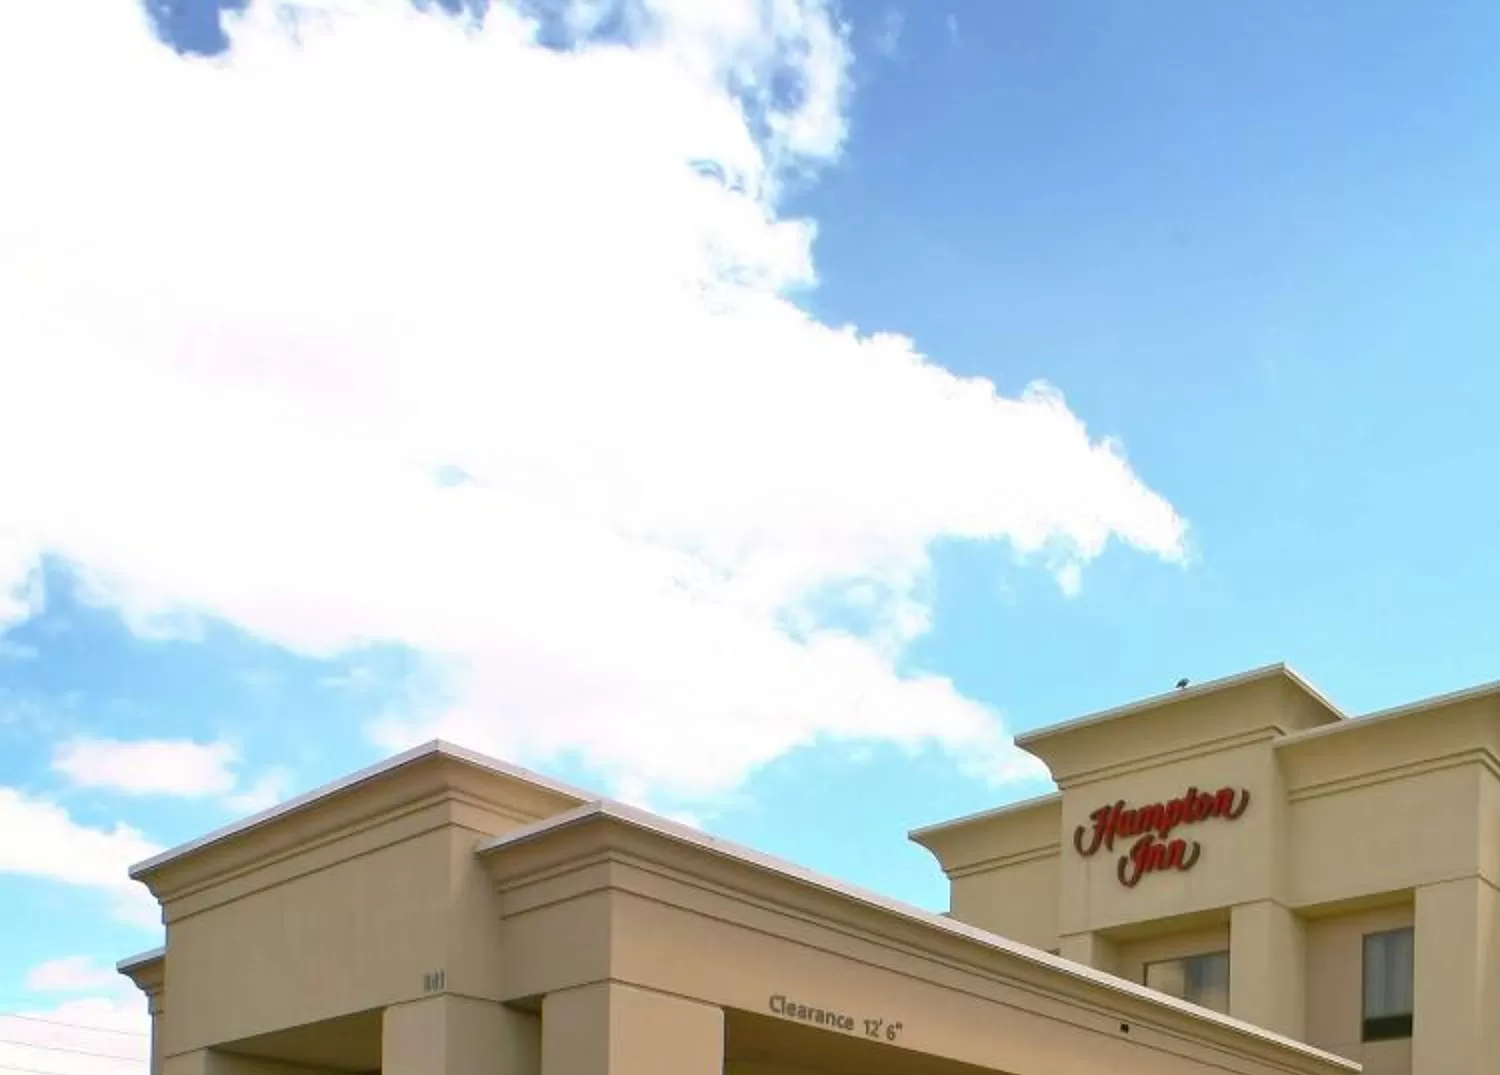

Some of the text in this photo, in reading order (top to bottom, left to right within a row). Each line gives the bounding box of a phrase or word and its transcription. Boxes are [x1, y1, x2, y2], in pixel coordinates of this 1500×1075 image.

[1073, 786, 1250, 857] Hampton
[1117, 834, 1201, 888] Inn
[769, 993, 855, 1031] Clearance
